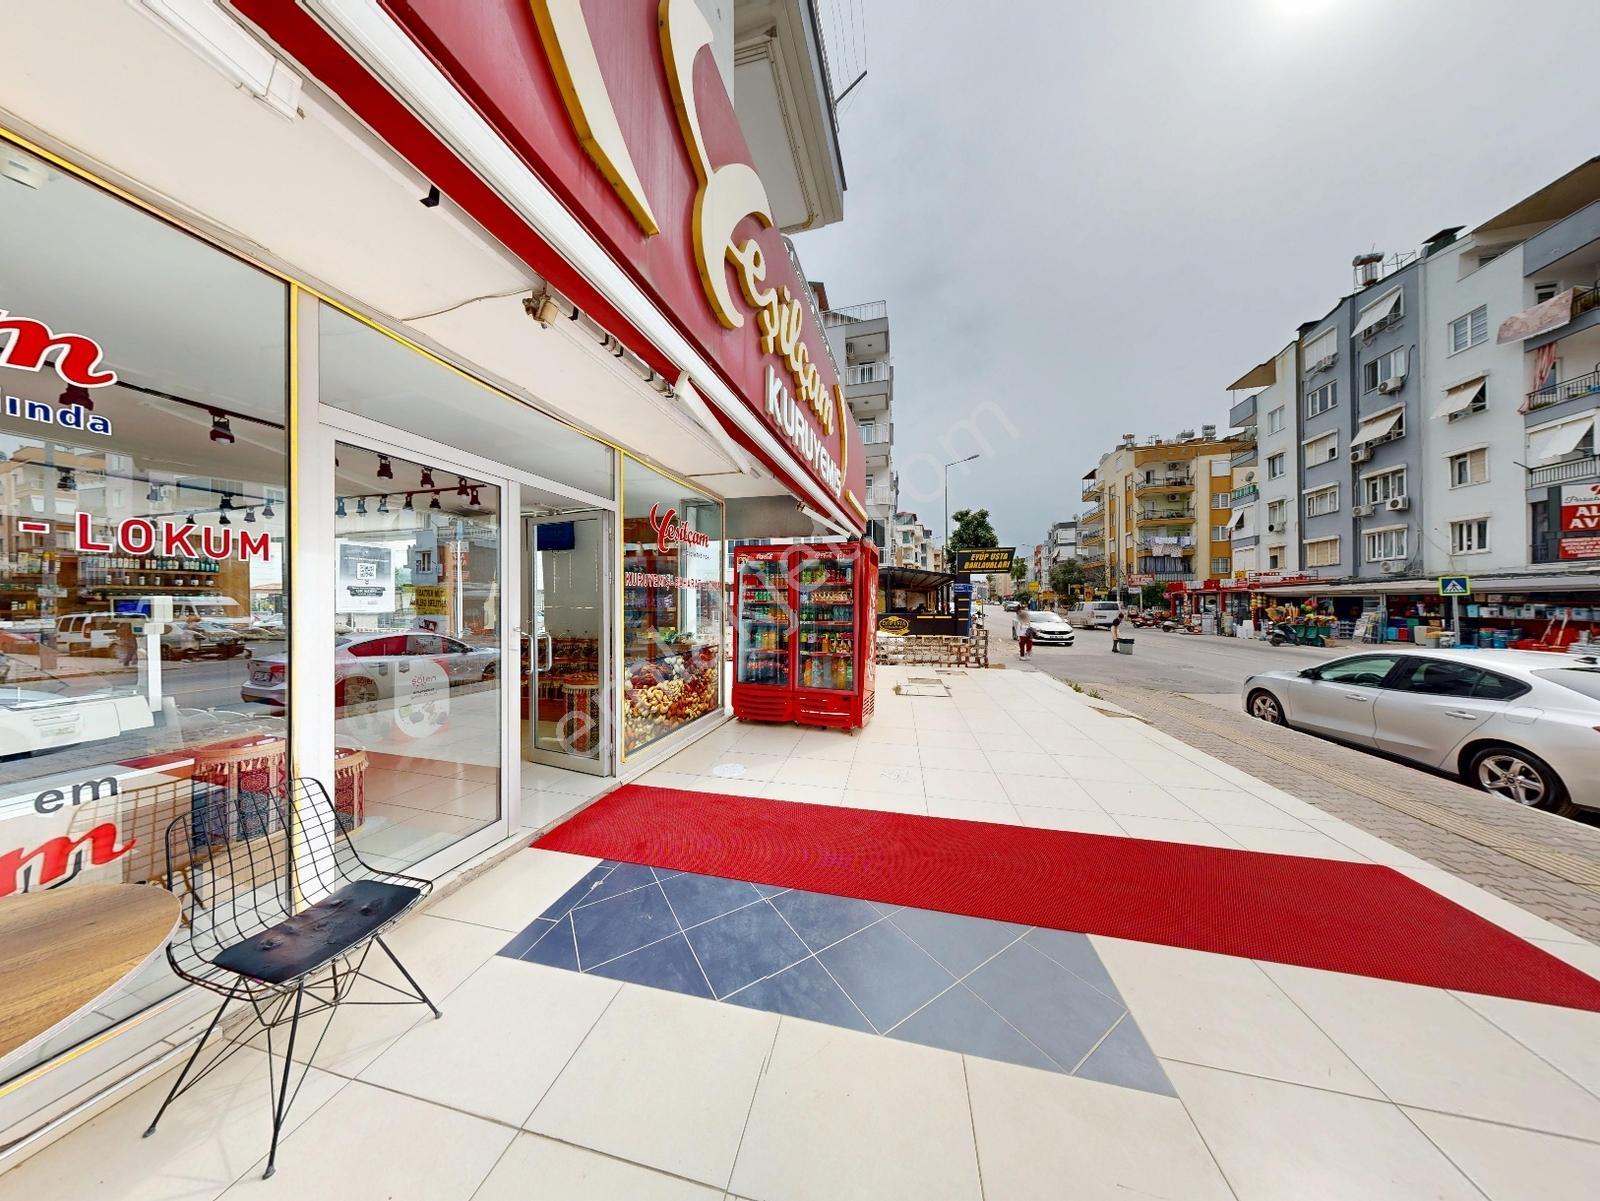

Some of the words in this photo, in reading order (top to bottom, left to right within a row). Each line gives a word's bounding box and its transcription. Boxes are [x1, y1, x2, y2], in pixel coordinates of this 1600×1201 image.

[0, 394, 112, 436] ında
[75, 511, 271, 562] LOKUM
[964, 560, 1011, 570] BAKLAVALARI
[970, 552, 988, 561] EYÜP
[990, 552, 1008, 560] USTA
